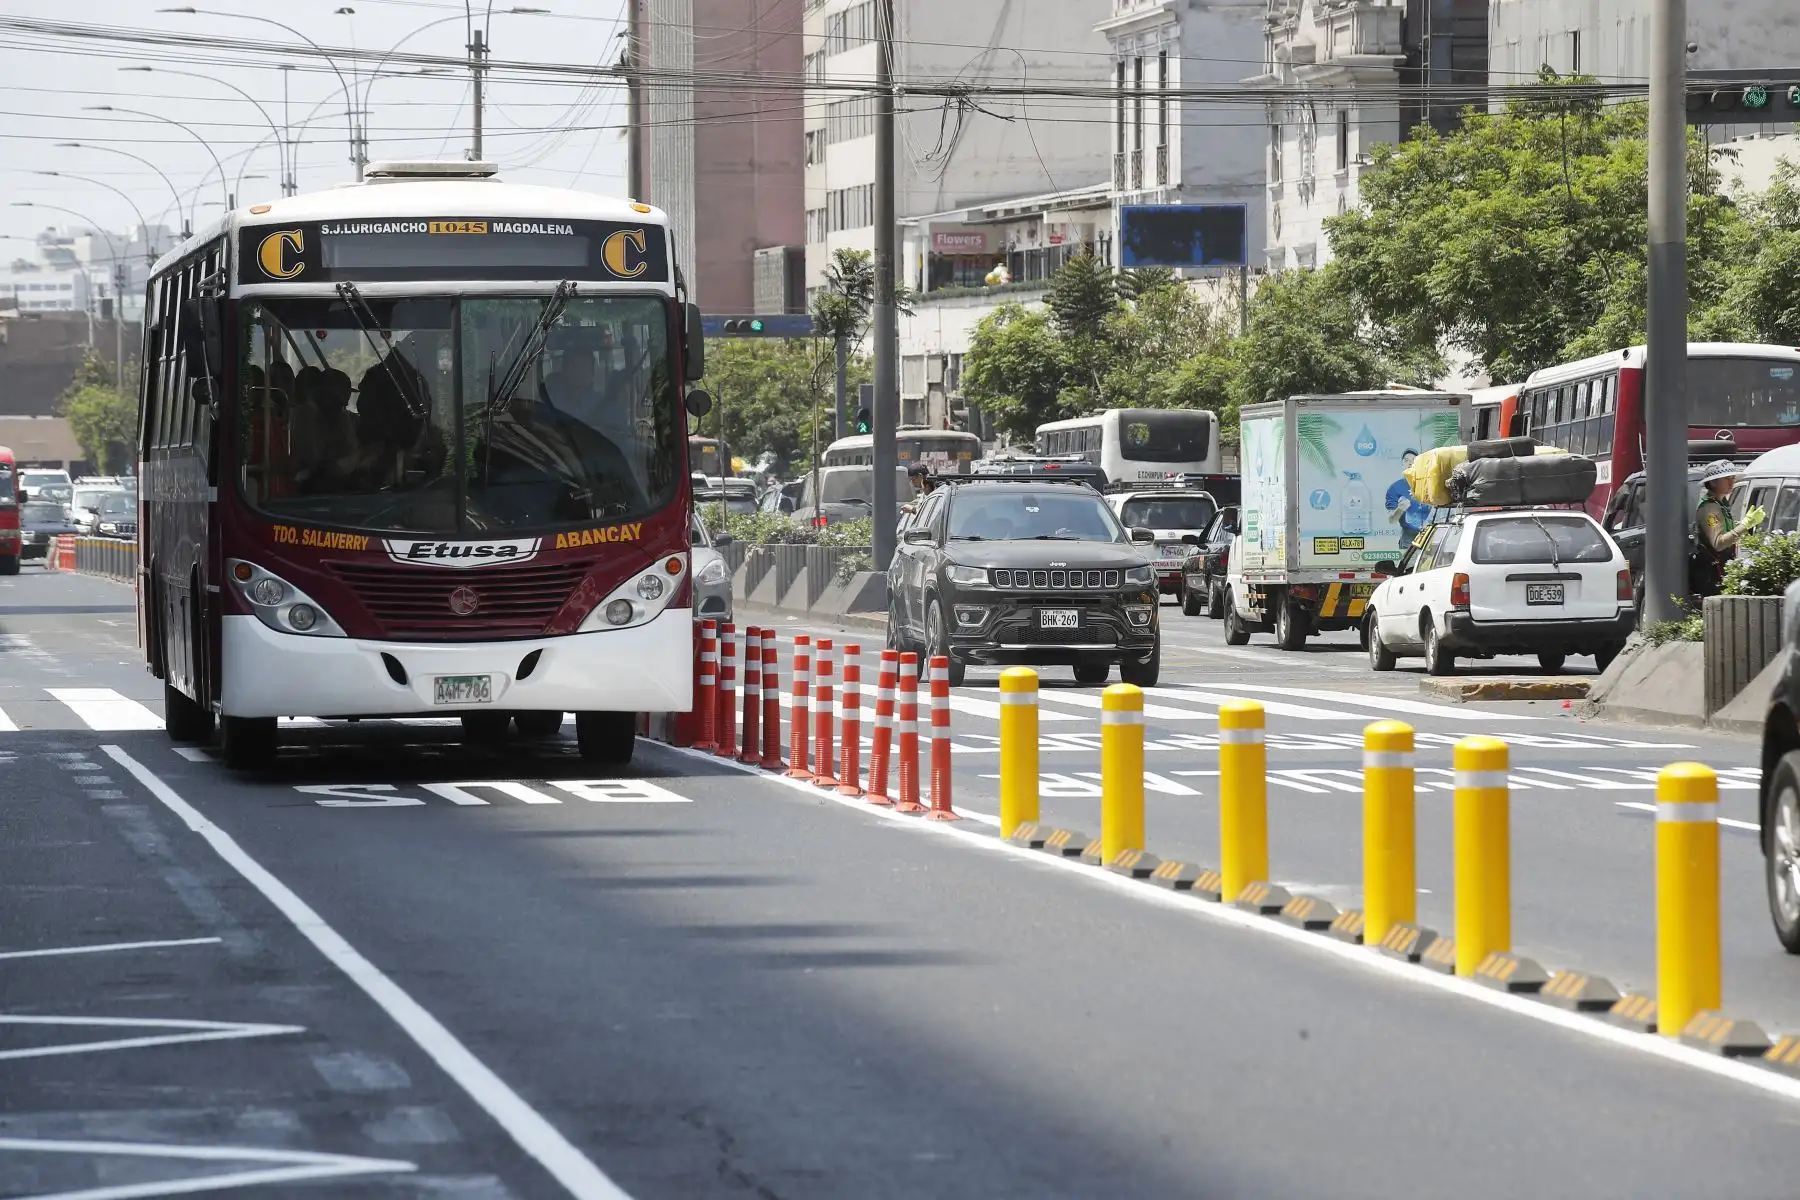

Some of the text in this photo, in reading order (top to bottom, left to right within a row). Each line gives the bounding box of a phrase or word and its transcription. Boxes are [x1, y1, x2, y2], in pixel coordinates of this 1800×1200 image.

[321, 222, 574, 235] S.J.LURIGANCHO 1045 MAGDALENA
[937, 233, 982, 245] Flowers
[257, 229, 305, 279] C
[601, 229, 648, 278] C
[1315, 491, 1325, 503] 7
[273, 525, 369, 551] TDO. SALAVERRY
[555, 522, 642, 549] ABANCAY
[407, 542, 519, 559] Etusa
[1042, 615, 1077, 626] BHK-269
[293, 778, 695, 807] BUS
